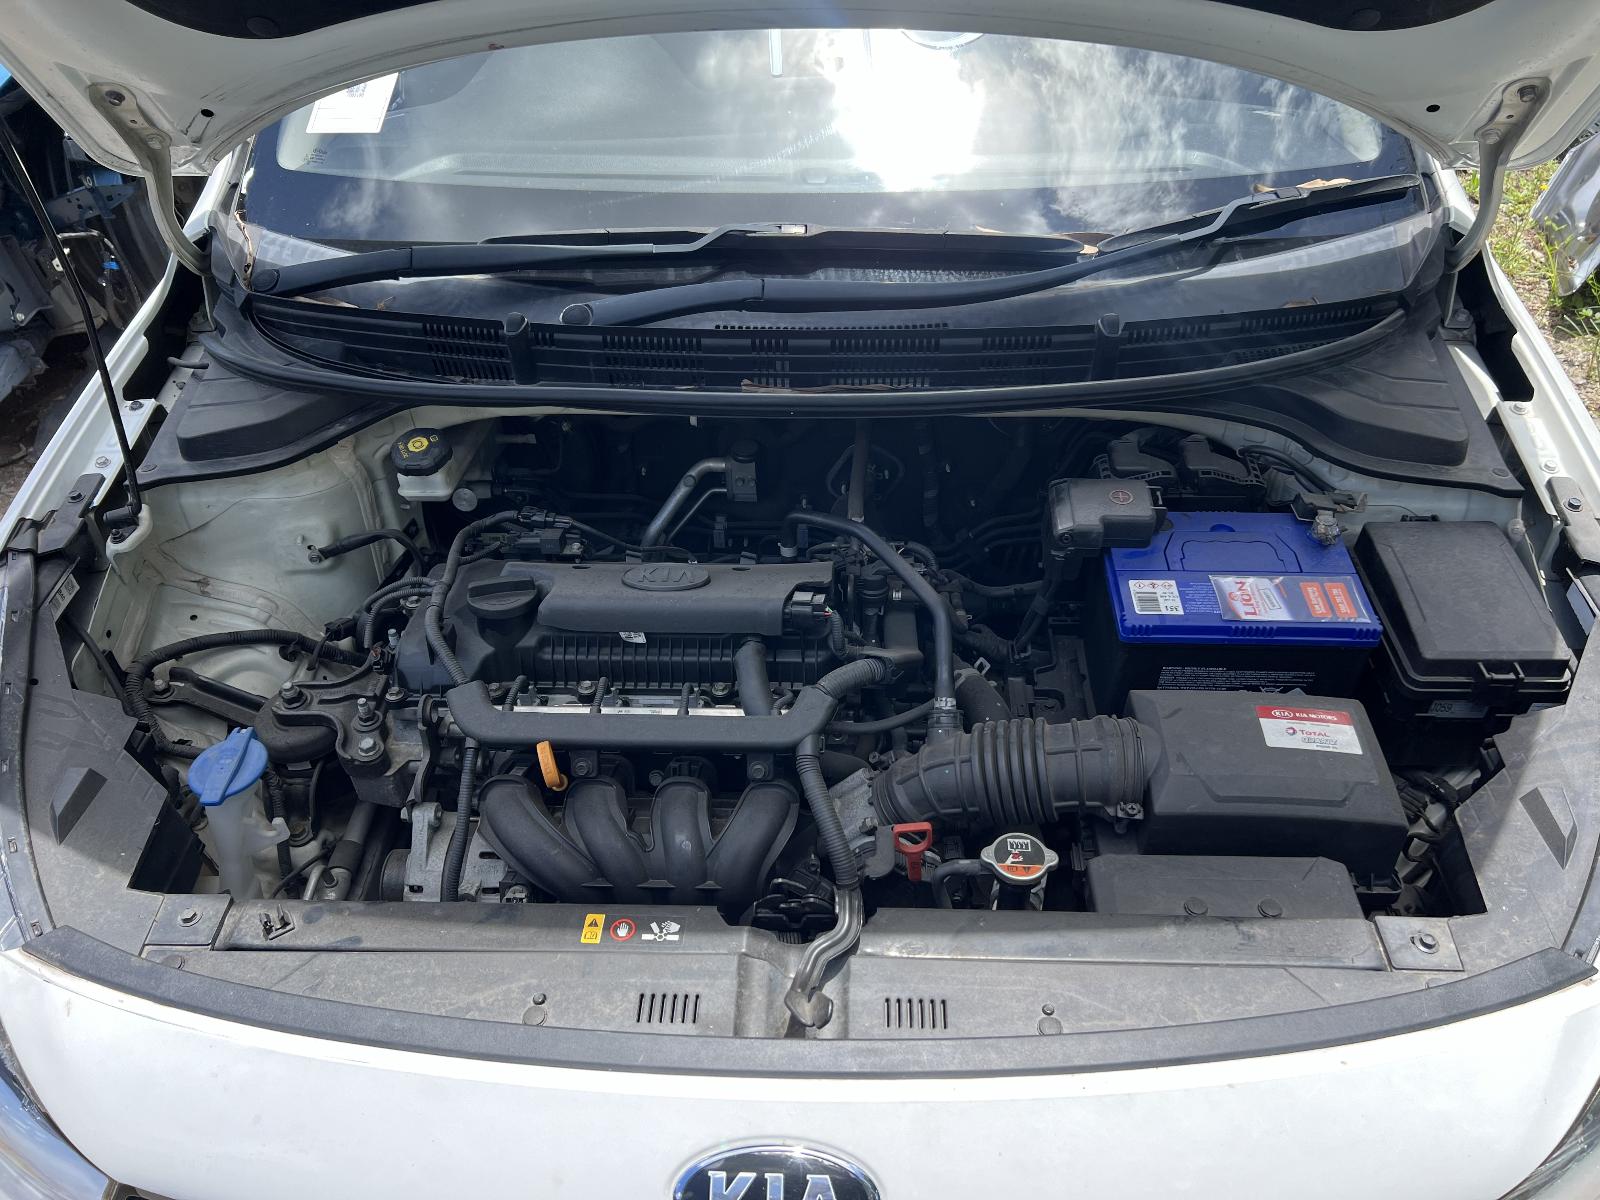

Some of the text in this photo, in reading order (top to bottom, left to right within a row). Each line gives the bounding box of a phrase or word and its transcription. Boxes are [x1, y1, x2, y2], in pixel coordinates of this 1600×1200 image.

[637, 567, 695, 583] KIA
[1234, 581, 1257, 616] LION
[708, 1170, 837, 1200] KIA
